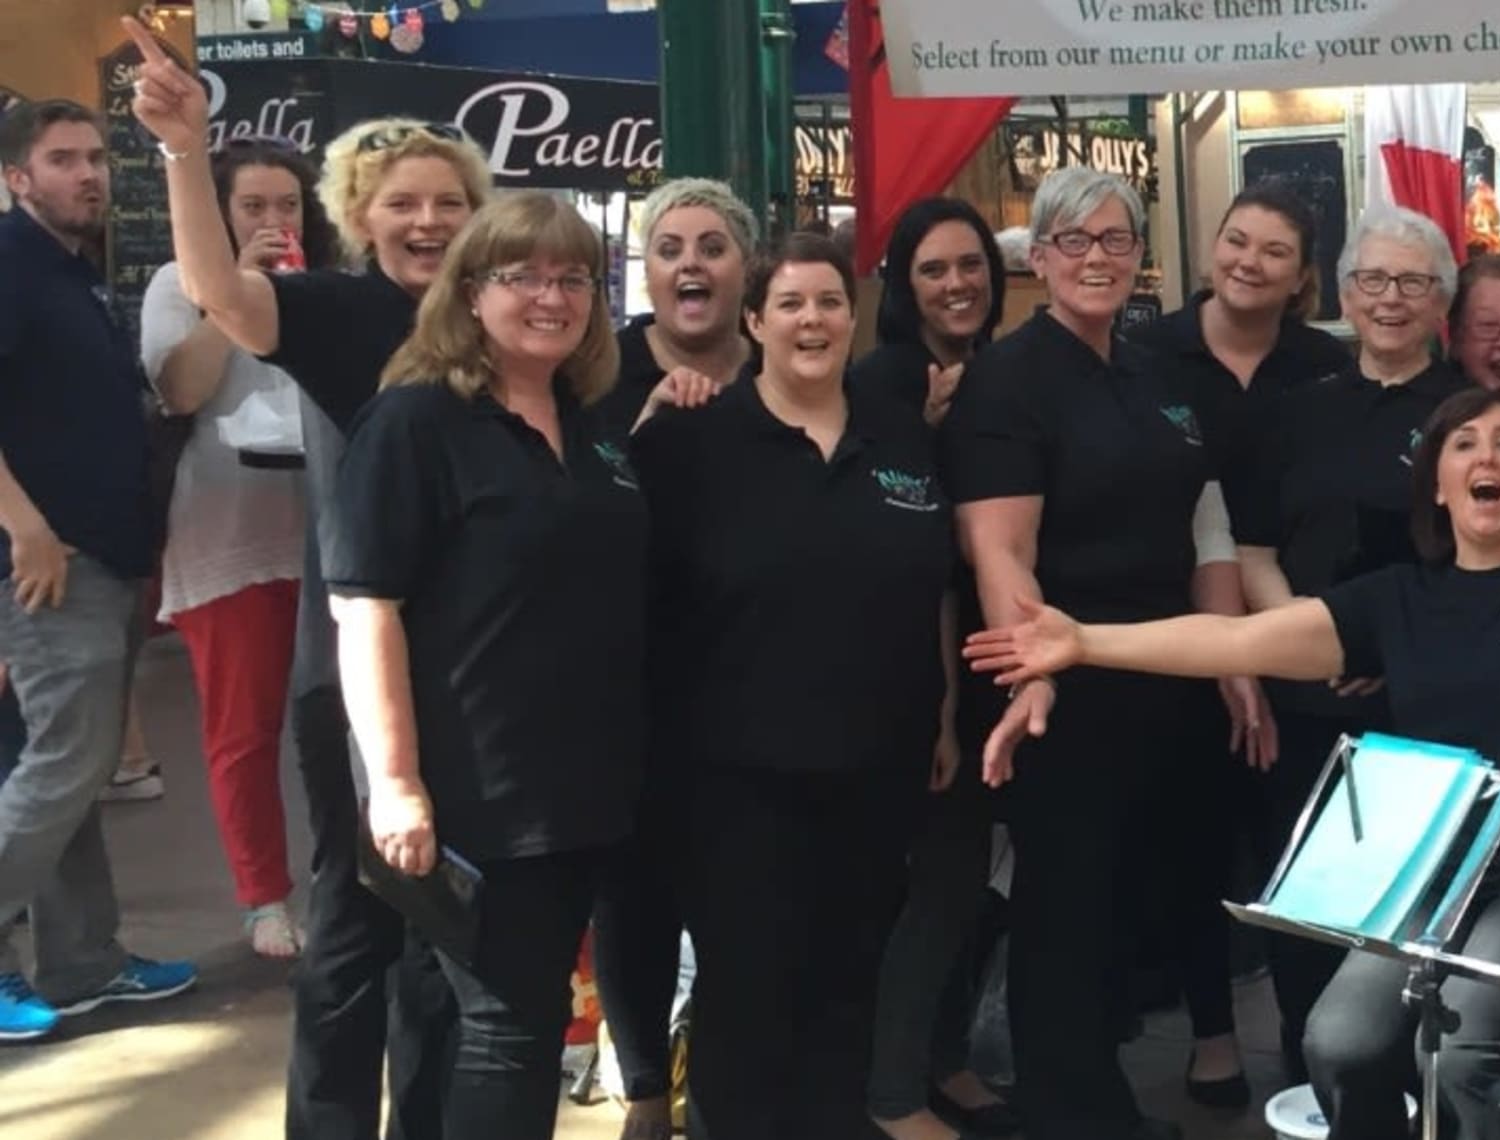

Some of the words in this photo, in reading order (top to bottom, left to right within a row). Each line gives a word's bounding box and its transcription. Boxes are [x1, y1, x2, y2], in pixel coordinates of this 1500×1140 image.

[1079, 0, 1123, 22] We
[1133, 0, 1202, 21] make
[1214, 0, 1282, 20] them
[218, 40, 266, 60] toilets
[273, 37, 304, 57] and
[911, 42, 978, 69] Select
[990, 40, 1047, 67] from
[1056, 48, 1099, 66] our
[1110, 45, 1184, 65] menu
[1194, 45, 1224, 63] or
[1233, 32, 1307, 61] make
[1315, 36, 1380, 64] your
[1390, 33, 1452, 54] own
[453, 81, 663, 176] Paella
